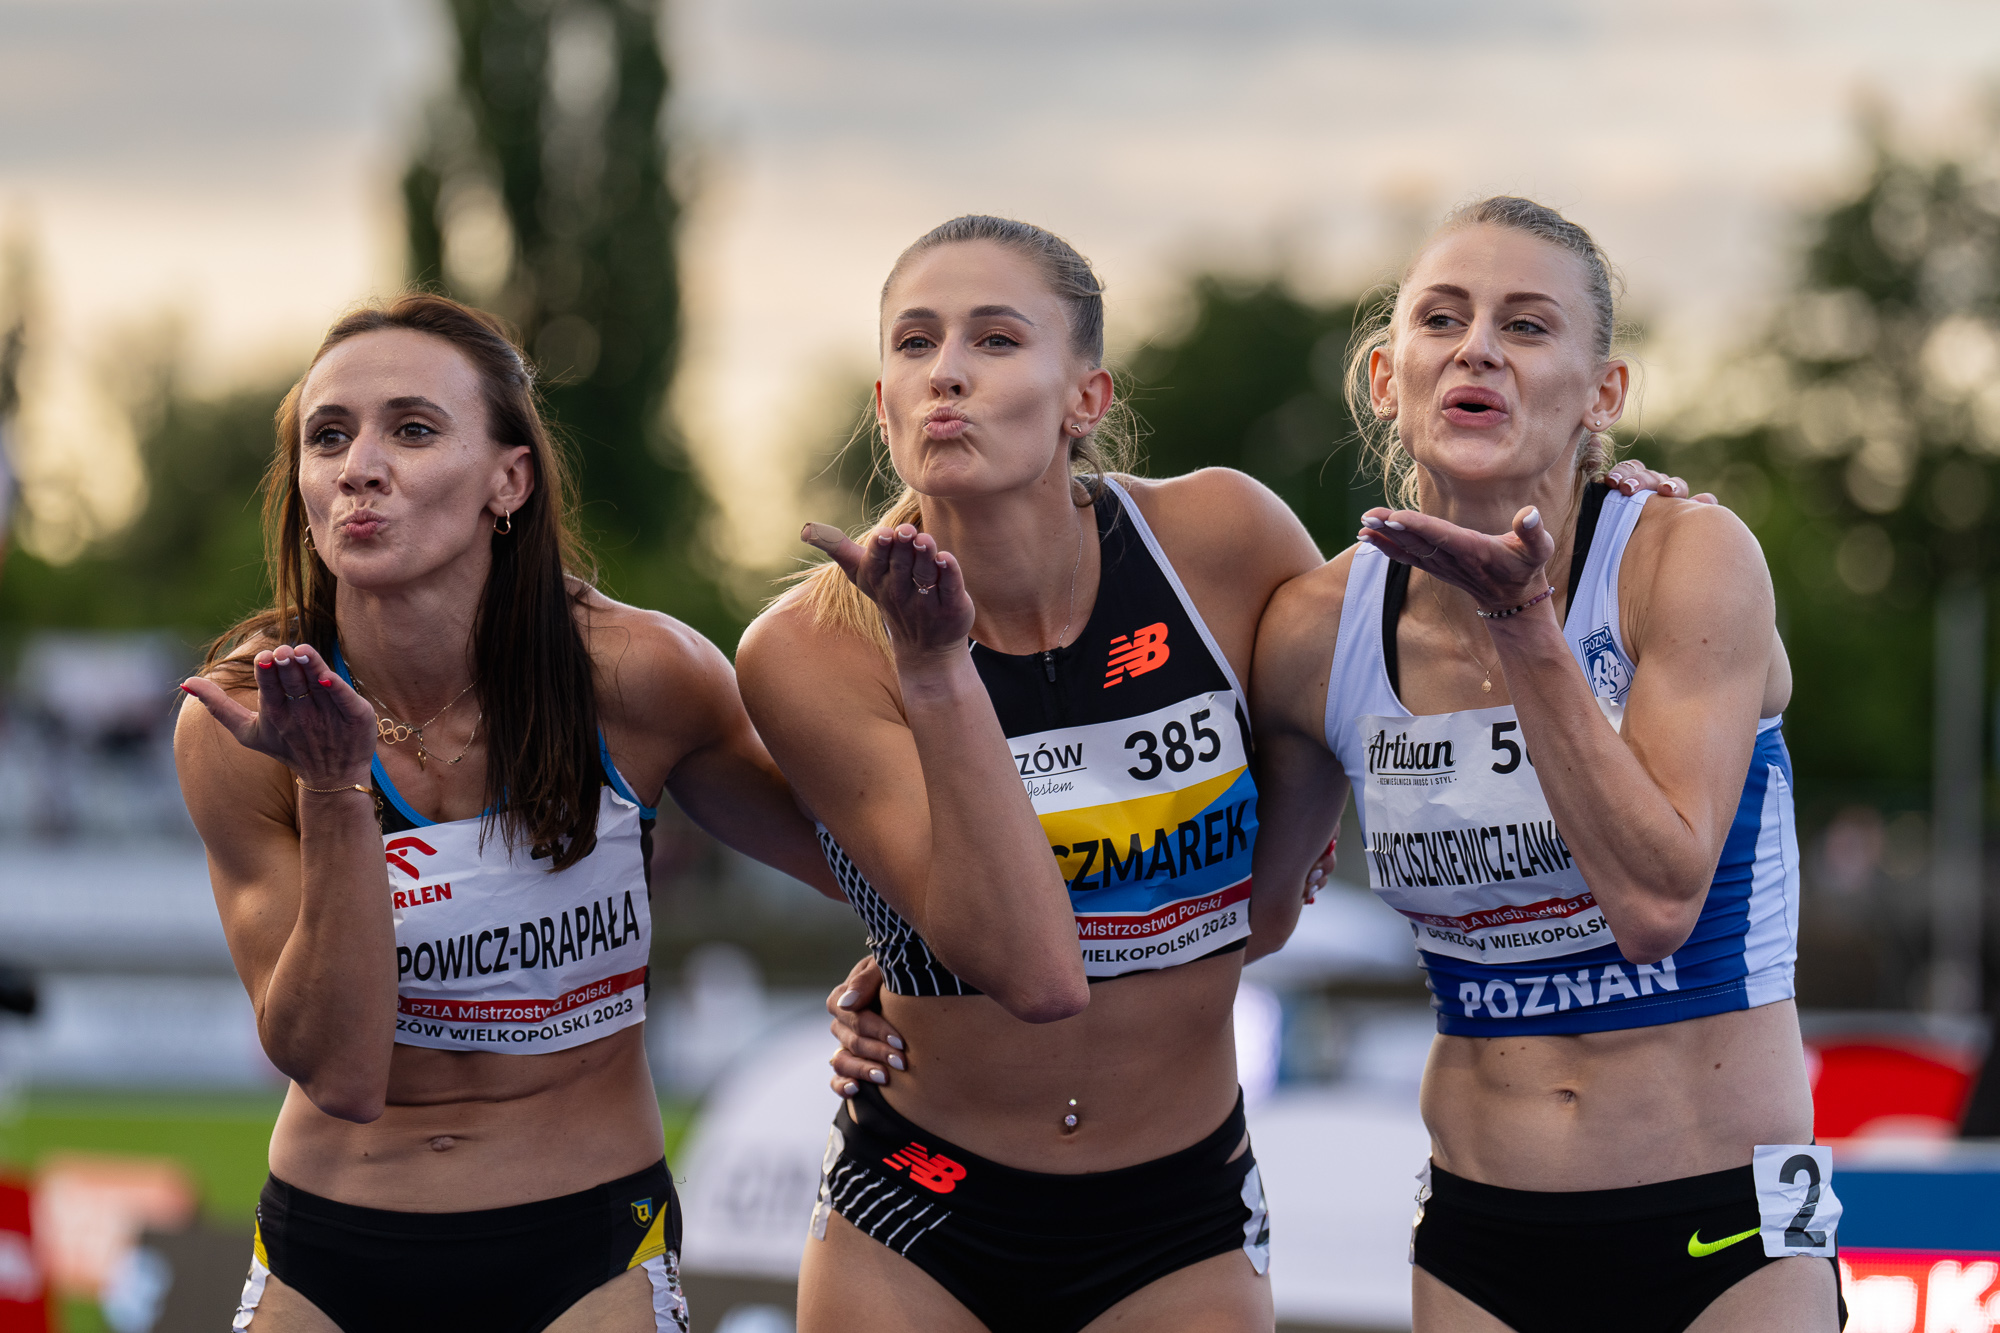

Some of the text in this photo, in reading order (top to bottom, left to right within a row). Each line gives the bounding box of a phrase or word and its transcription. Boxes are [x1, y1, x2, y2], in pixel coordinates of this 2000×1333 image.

[1014, 742, 1083, 775] ZÓW
[1124, 709, 1221, 781] 385
[1368, 729, 1456, 774] Artisan
[1434, 776, 1452, 785] STYL
[396, 890, 640, 982] POWICZ-DRAPAŁA
[1077, 895, 1222, 936] Mistrzostwa Polski
[1202, 911, 1237, 938] 2023
[411, 1003, 453, 1018] PZLA
[458, 1000, 563, 1020] Mistrzostwa
[566, 980, 612, 1009] Polski
[449, 1014, 590, 1043] WIELKOPOLSKI
[593, 998, 634, 1025] 2023
[1779, 1154, 1827, 1248] 2
